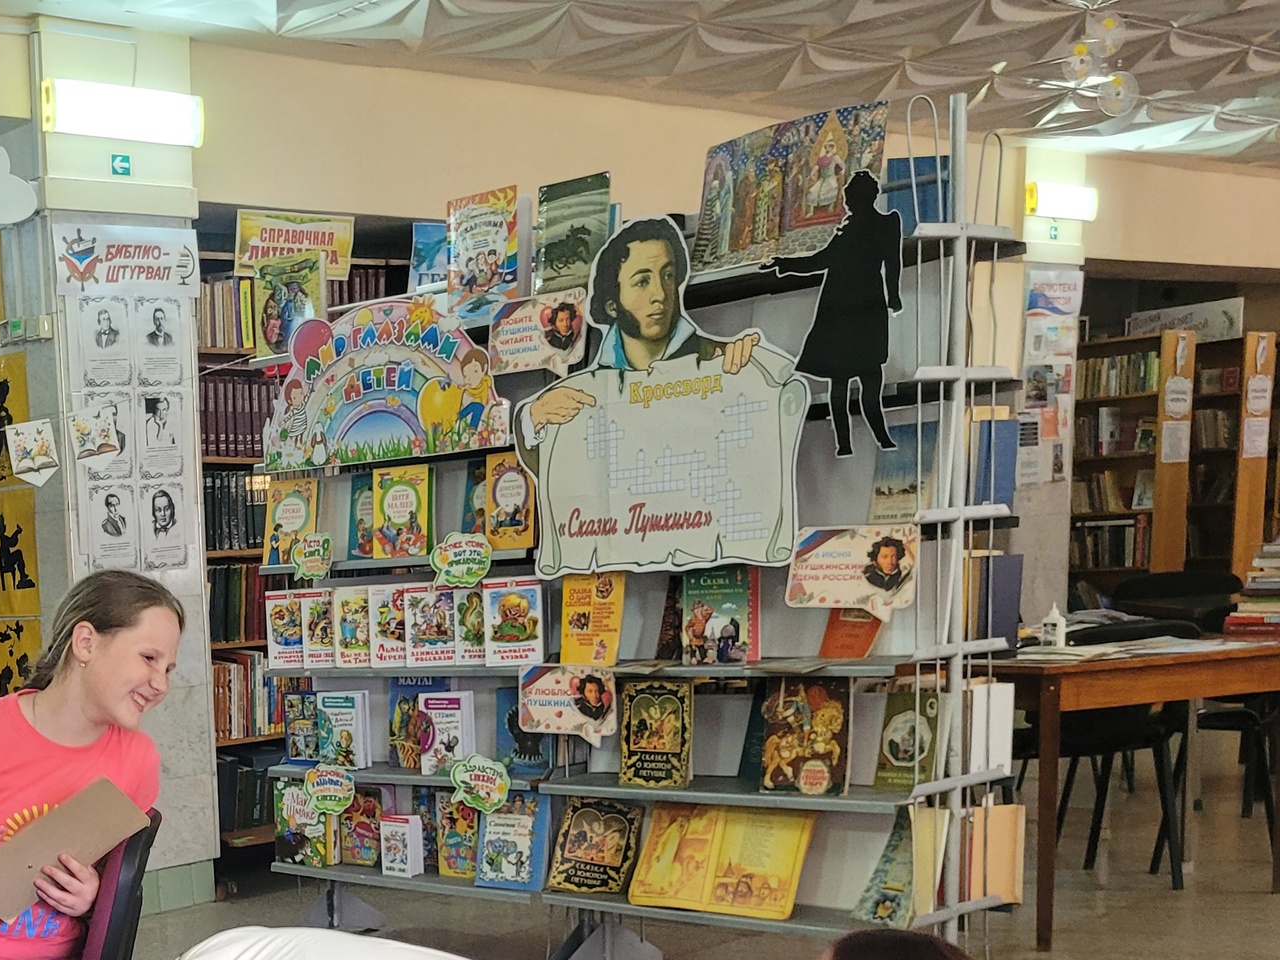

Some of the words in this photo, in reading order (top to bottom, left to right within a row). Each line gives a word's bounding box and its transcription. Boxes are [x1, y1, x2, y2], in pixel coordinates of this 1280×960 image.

[260, 228, 335, 247] СПРАВОЧНАЯ
[105, 244, 170, 262] БИБЛИО-
[105, 265, 172, 283] ШТУРВАЛ
[500, 315, 533, 326] ЛЮБИТЕ
[351, 317, 461, 363] ГЛАЗАМИ
[500, 335, 533, 345] ЧИТАЙТЕ
[305, 335, 347, 383] МИР
[342, 361, 414, 403] ДЕТЕЙ
[629, 374, 723, 408] Кроссворд
[392, 494, 410, 502] ВИТЯ
[624, 503, 713, 542] Пушкина»
[535, 688, 572, 696] ЛЮБЛЮ
[527, 699, 571, 707] ПУШКИНА
[576, 863, 604, 872] СКАЗКА
